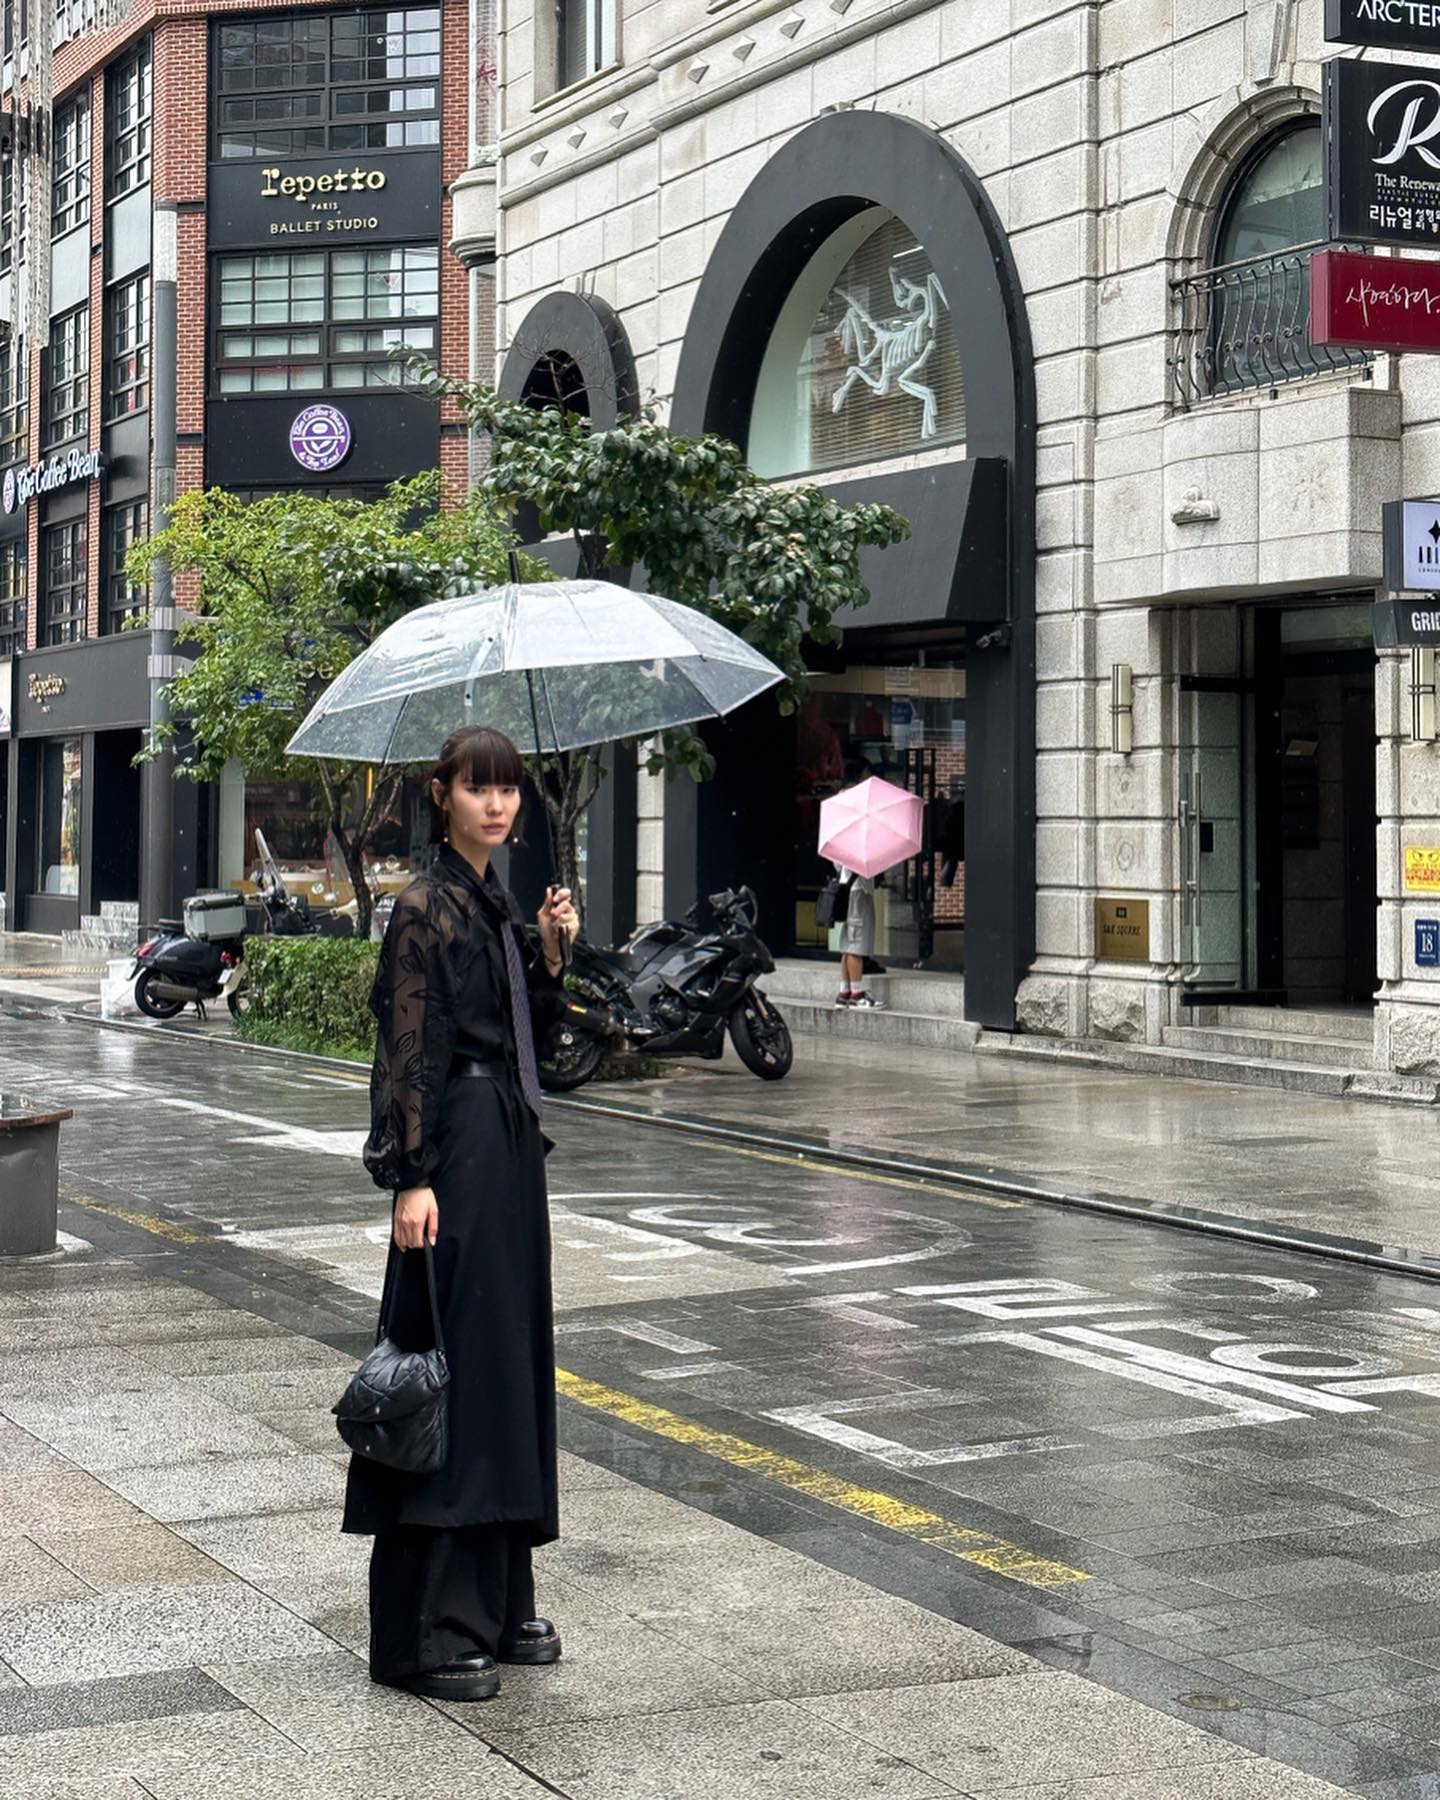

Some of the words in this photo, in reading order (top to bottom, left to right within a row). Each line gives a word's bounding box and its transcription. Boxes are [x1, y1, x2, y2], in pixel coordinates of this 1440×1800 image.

[261, 167, 386, 201] repetto
[1375, 172, 1397, 188] The
[311, 202, 338, 210] PARIS
[270, 221, 321, 234] BALLET
[326, 217, 378, 231] STUDIO
[1369, 204, 1412, 230] 리뉴얼
[16, 464, 36, 506] The
[35, 455, 67, 494] Coffee
[67, 447, 101, 482] Bean
[1421, 932, 1434, 953] 18
